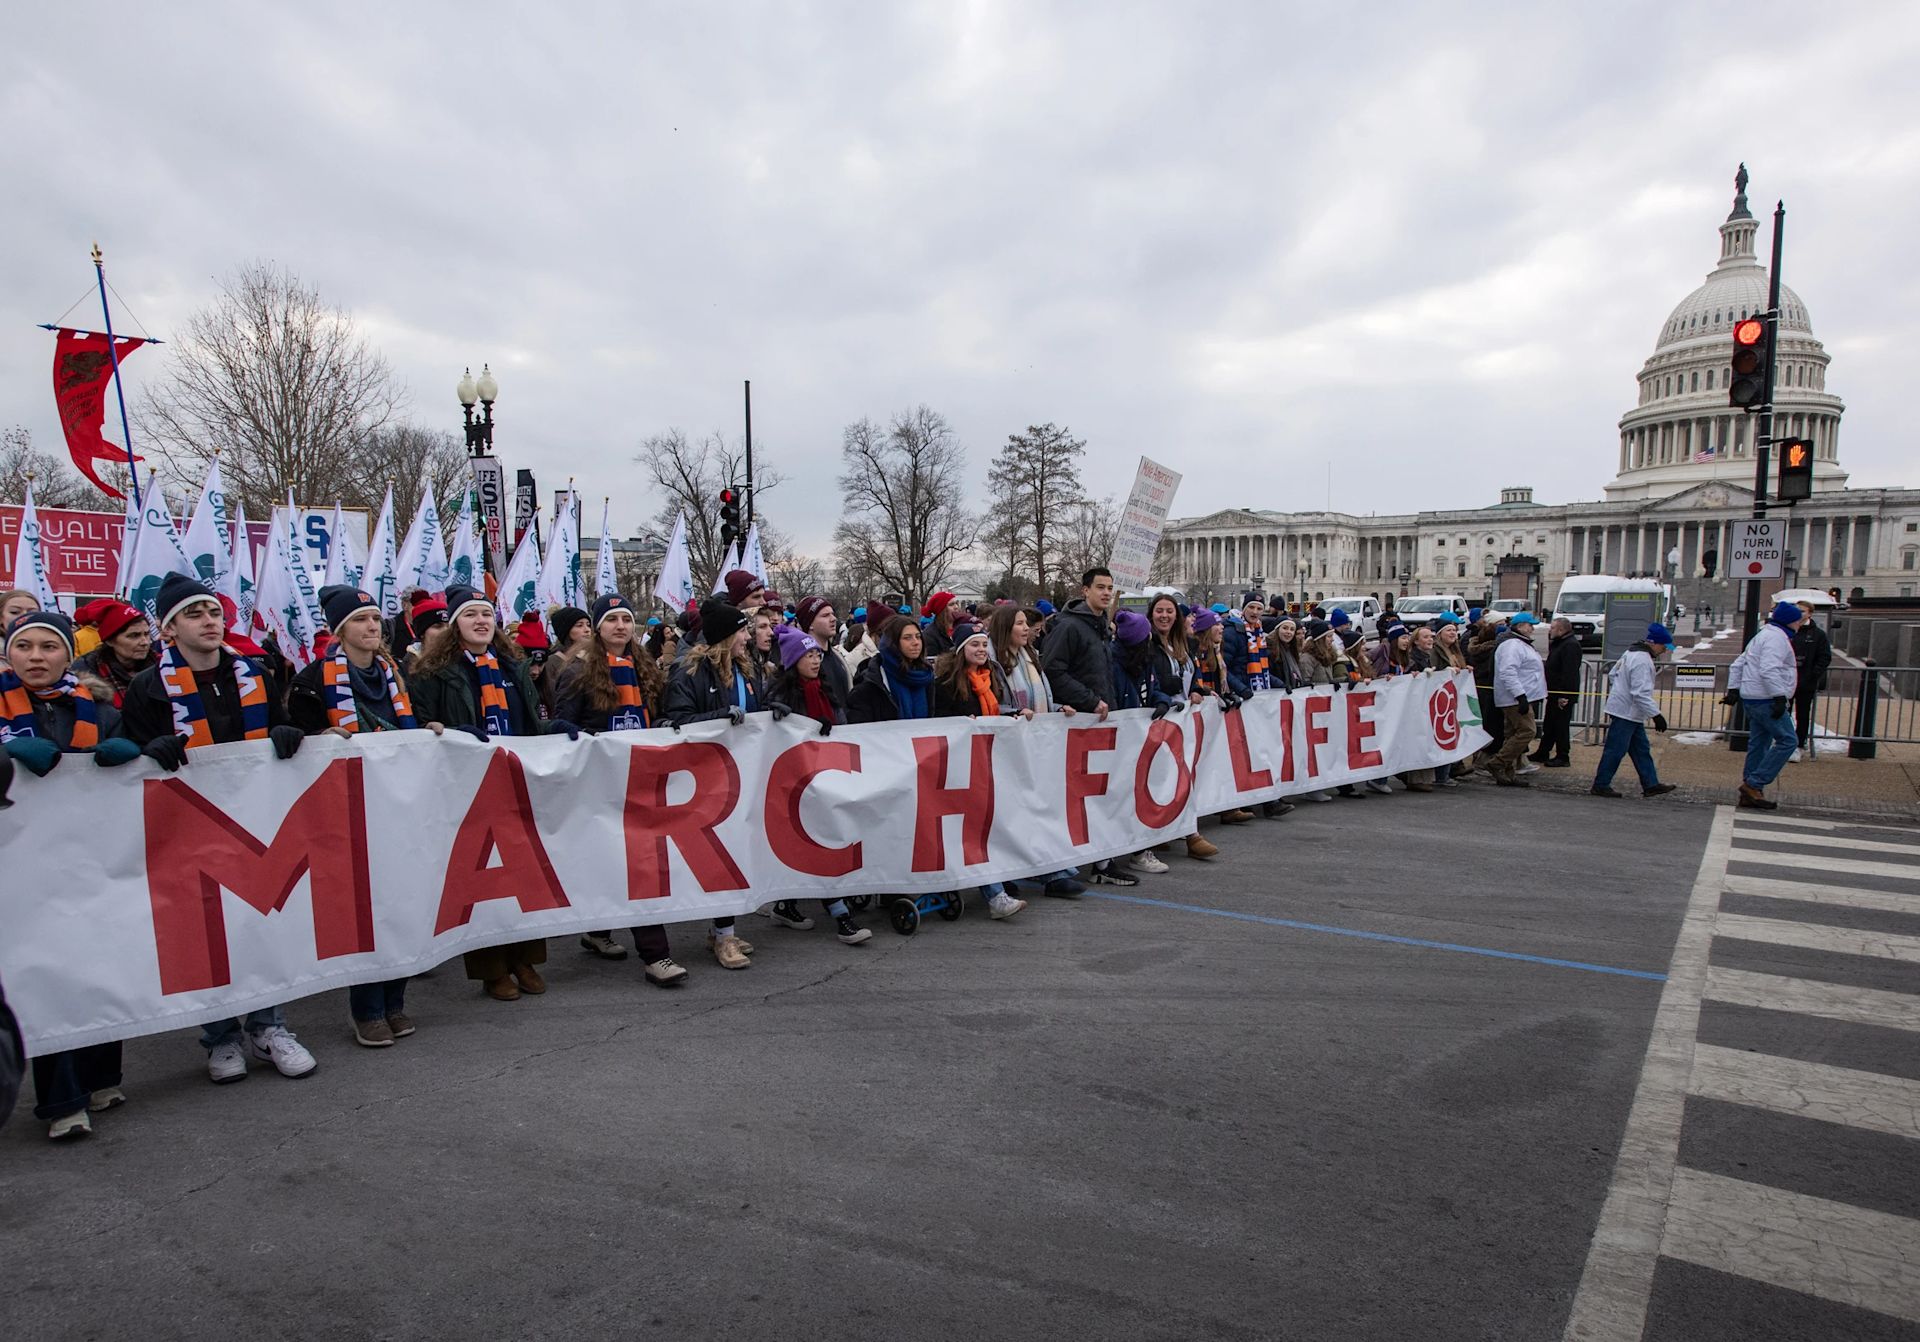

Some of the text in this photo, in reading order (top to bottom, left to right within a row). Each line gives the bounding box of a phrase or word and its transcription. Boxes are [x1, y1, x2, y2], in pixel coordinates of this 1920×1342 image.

[2, 516, 127, 543] EQUALIT
[1747, 524, 1770, 535] NO
[1743, 538, 1773, 547] TURN
[60, 552, 106, 570] THE
[1734, 550, 1779, 560] ON RED
[144, 733, 994, 995] MARCH
[1225, 691, 1383, 792] LIFE
